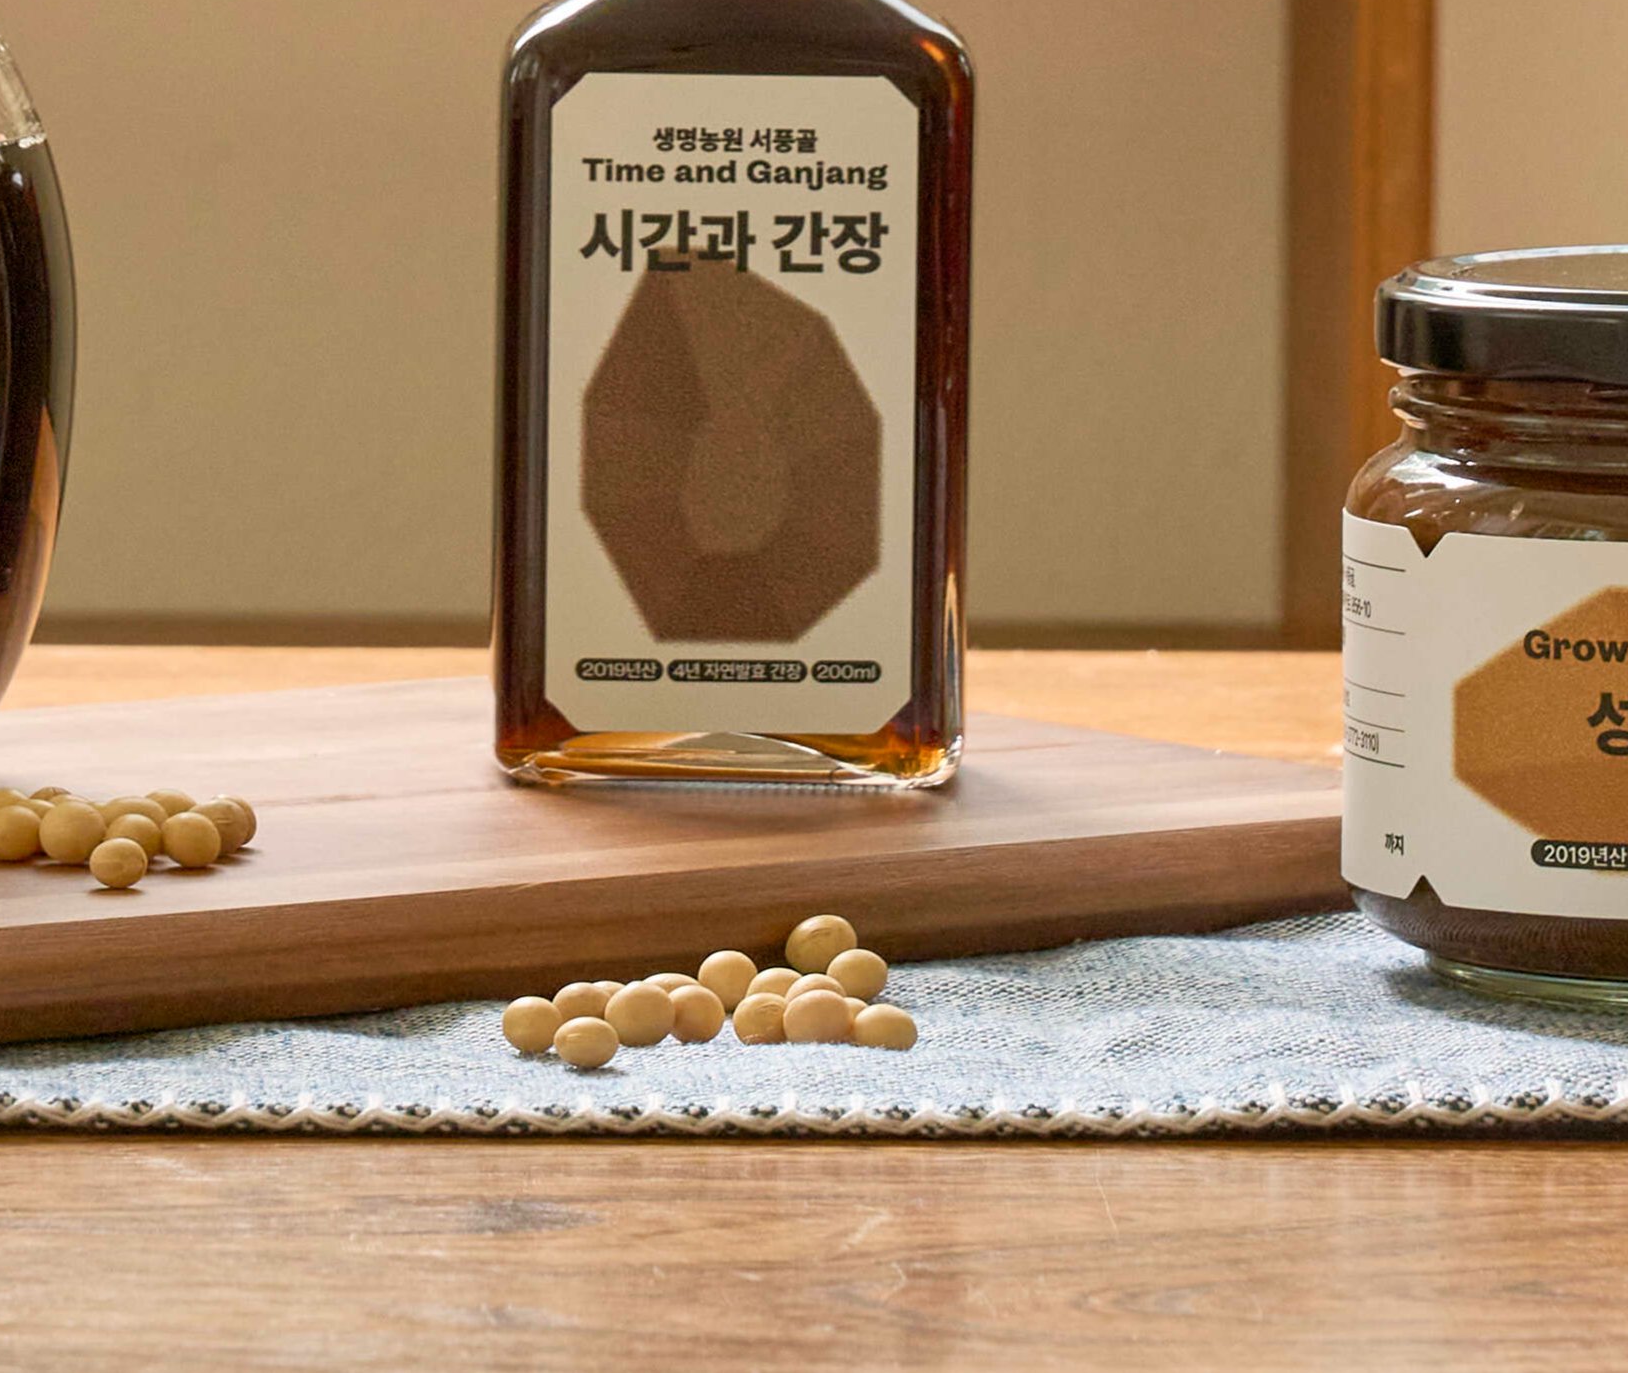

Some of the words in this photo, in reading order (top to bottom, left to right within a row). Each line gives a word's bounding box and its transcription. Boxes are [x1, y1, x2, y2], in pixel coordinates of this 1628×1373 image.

[653, 127, 743, 153] 생명농원
[749, 128, 818, 154] 서풍골
[582, 158, 665, 183] Time
[674, 160, 737, 184] and
[746, 160, 888, 191] Ganjang
[579, 209, 756, 274] 시간과
[772, 211, 889, 275] 간장
[671, 662, 701, 680] 4년
[704, 662, 767, 680] 자연발효
[815, 662, 877, 680] 200ml
[1542, 844, 1628, 867] 2019년산
